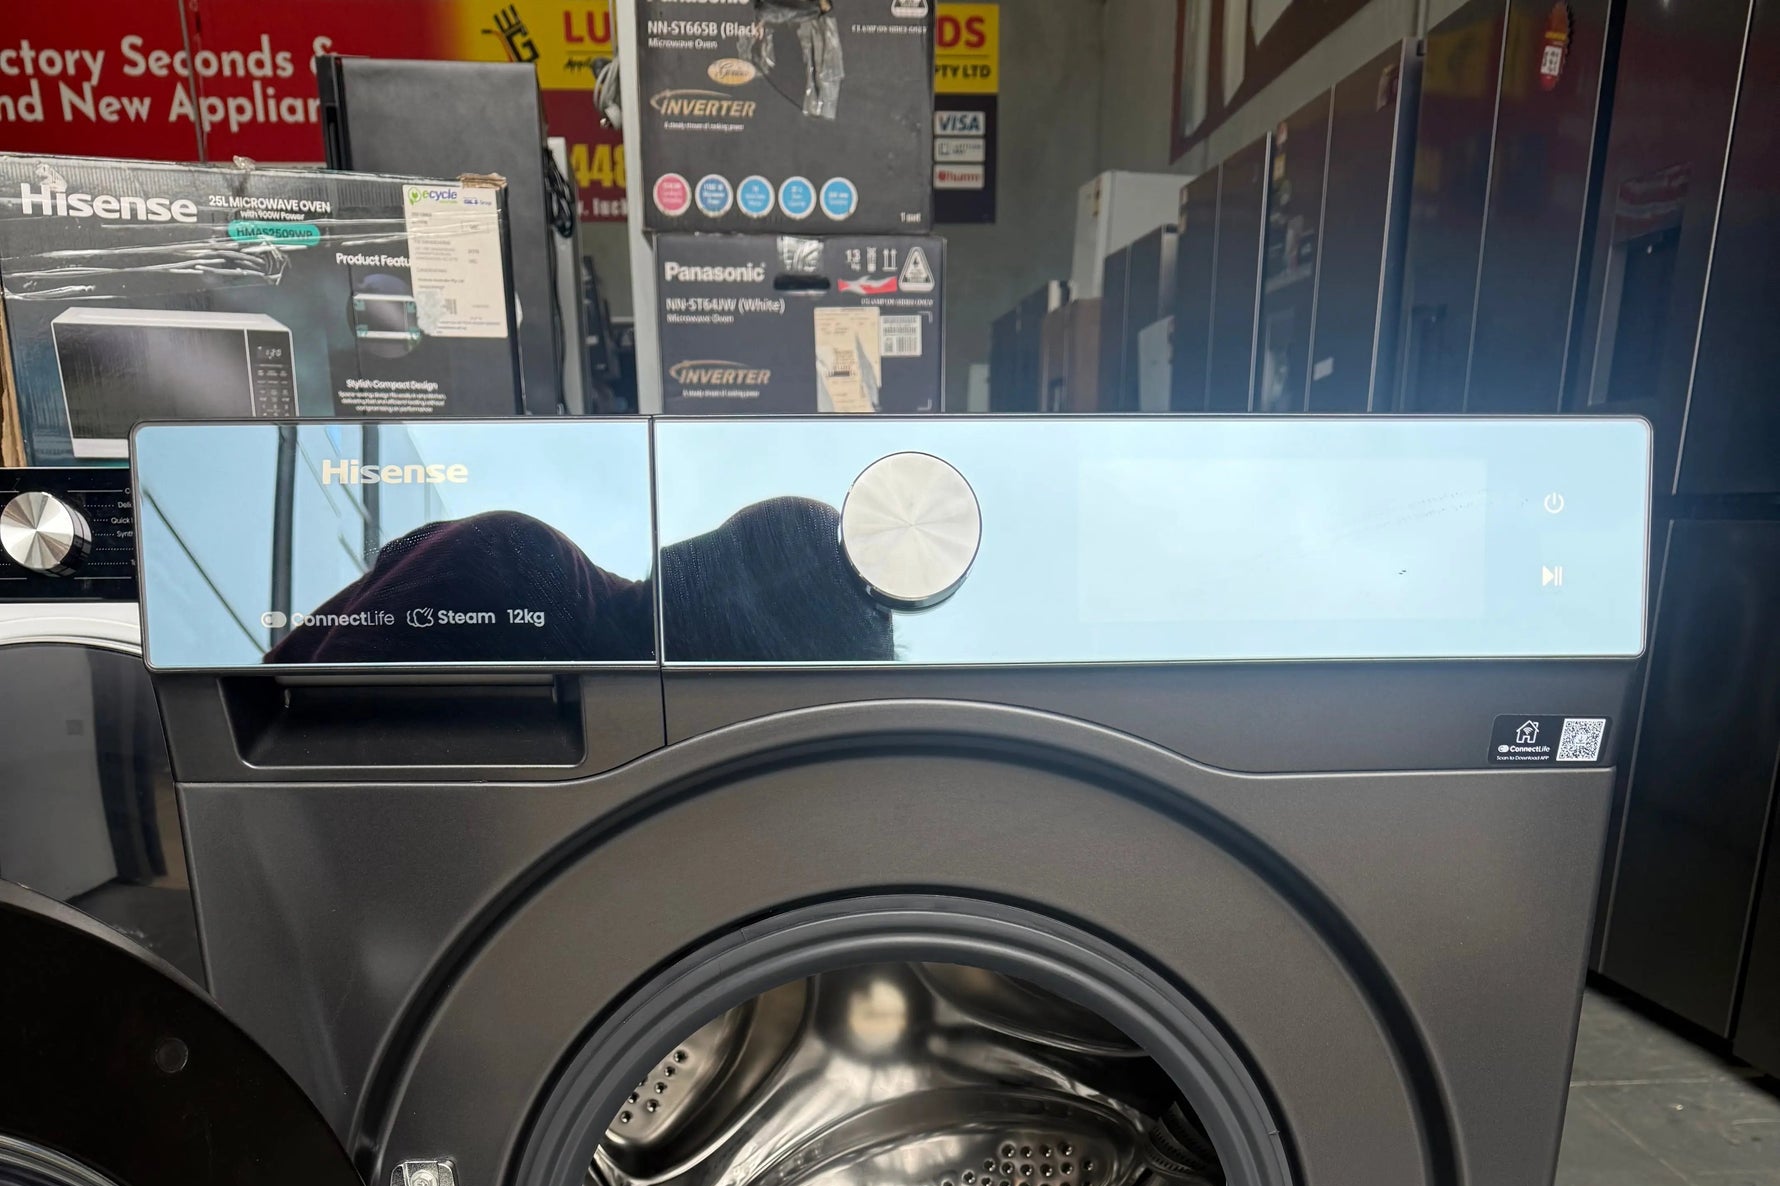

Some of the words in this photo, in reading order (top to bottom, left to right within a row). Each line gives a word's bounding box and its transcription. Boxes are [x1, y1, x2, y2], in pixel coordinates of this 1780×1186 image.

[647, 20, 718, 36] NN-ST665B
[121, 34, 294, 77] Seconds
[58, 80, 151, 122] New
[660, 98, 757, 117] INVERTER
[938, 115, 981, 132] VISA
[20, 182, 198, 222] Hisense
[208, 195, 228, 207] 25L
[229, 196, 298, 211] MICROWAVE
[300, 200, 331, 213] OVEN
[336, 253, 380, 267] Product
[664, 261, 766, 282] Panasonic
[679, 368, 772, 385] INVERTER
[322, 459, 469, 485] Hisense
[291, 610, 395, 628] ConnectLife
[438, 609, 496, 626] Steam
[507, 608, 546, 628] 12kg
[1510, 745, 1550, 753] ConnectLife
